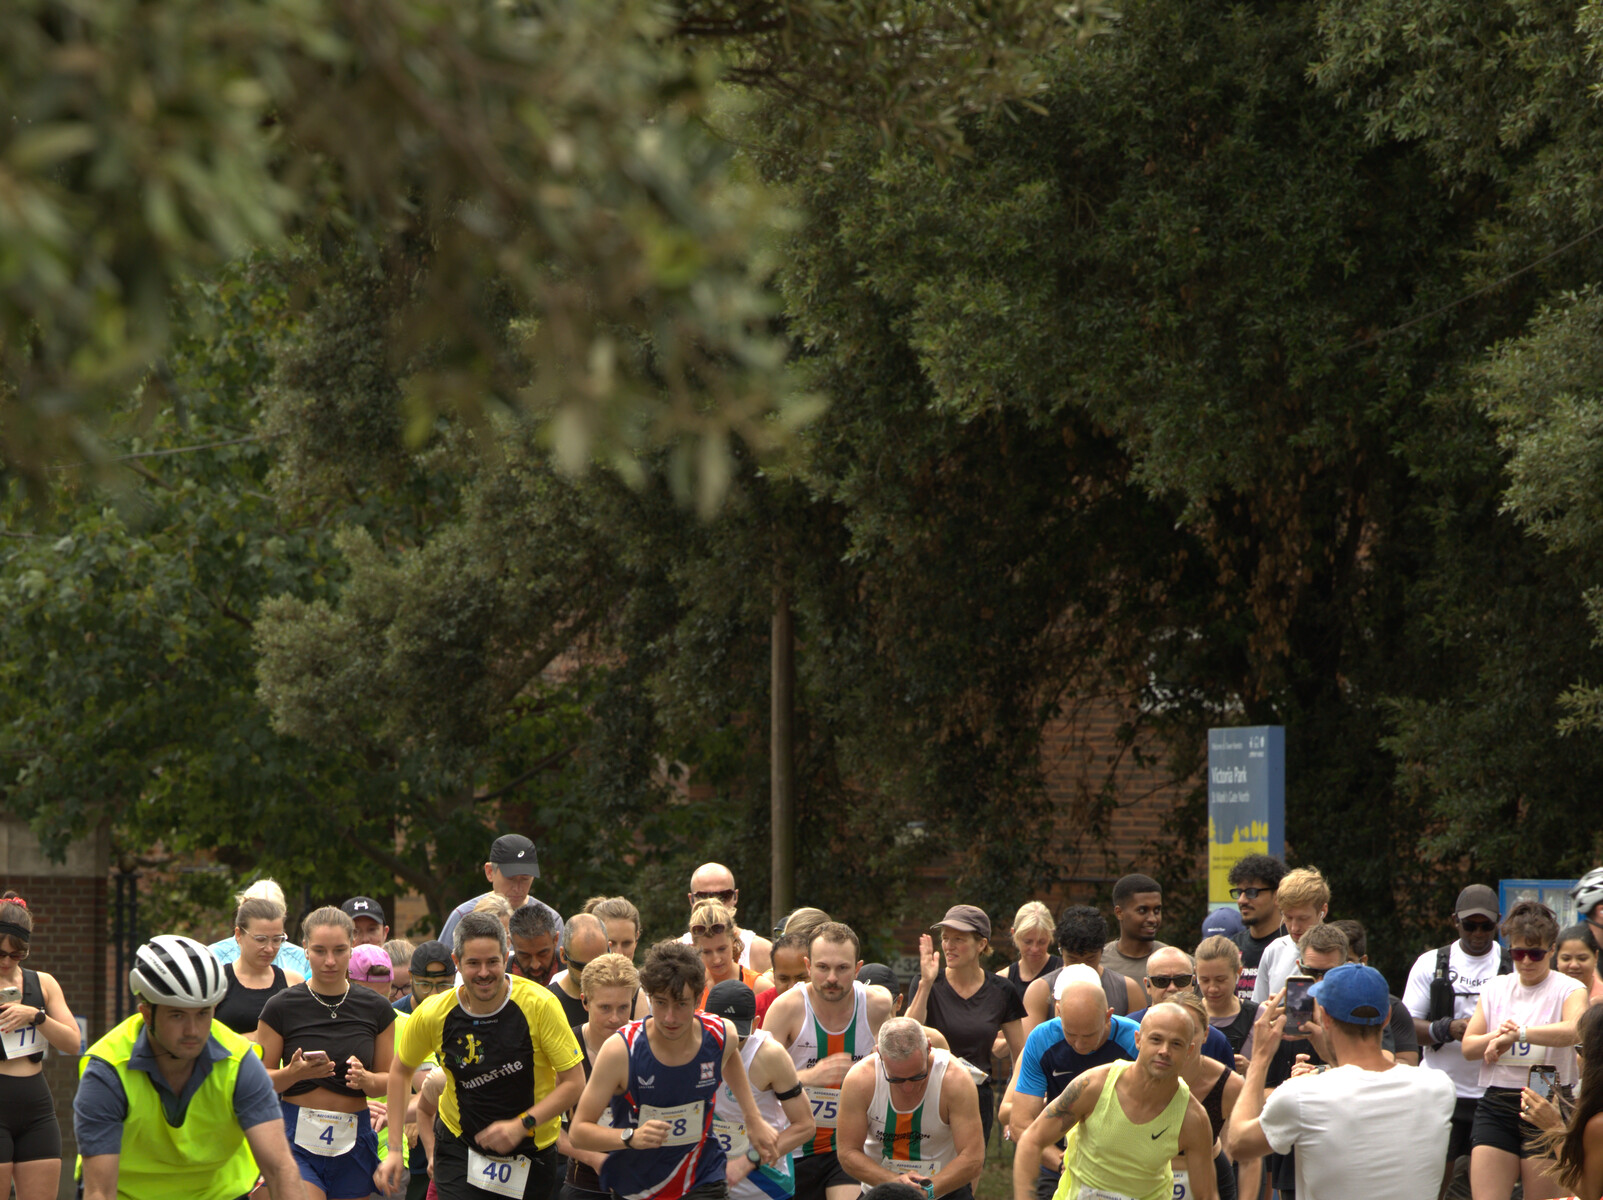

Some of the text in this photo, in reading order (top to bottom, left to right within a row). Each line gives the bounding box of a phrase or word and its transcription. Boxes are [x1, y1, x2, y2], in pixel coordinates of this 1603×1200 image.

[1211, 765, 1247, 783] Victoria Park
[1240, 967, 1259, 976] FINIS
[14, 1025, 36, 1047] 77
[810, 1099, 838, 1119] 75
[319, 1125, 335, 1145] 4
[719, 1134, 732, 1152] 3
[482, 1162, 512, 1184] 40
